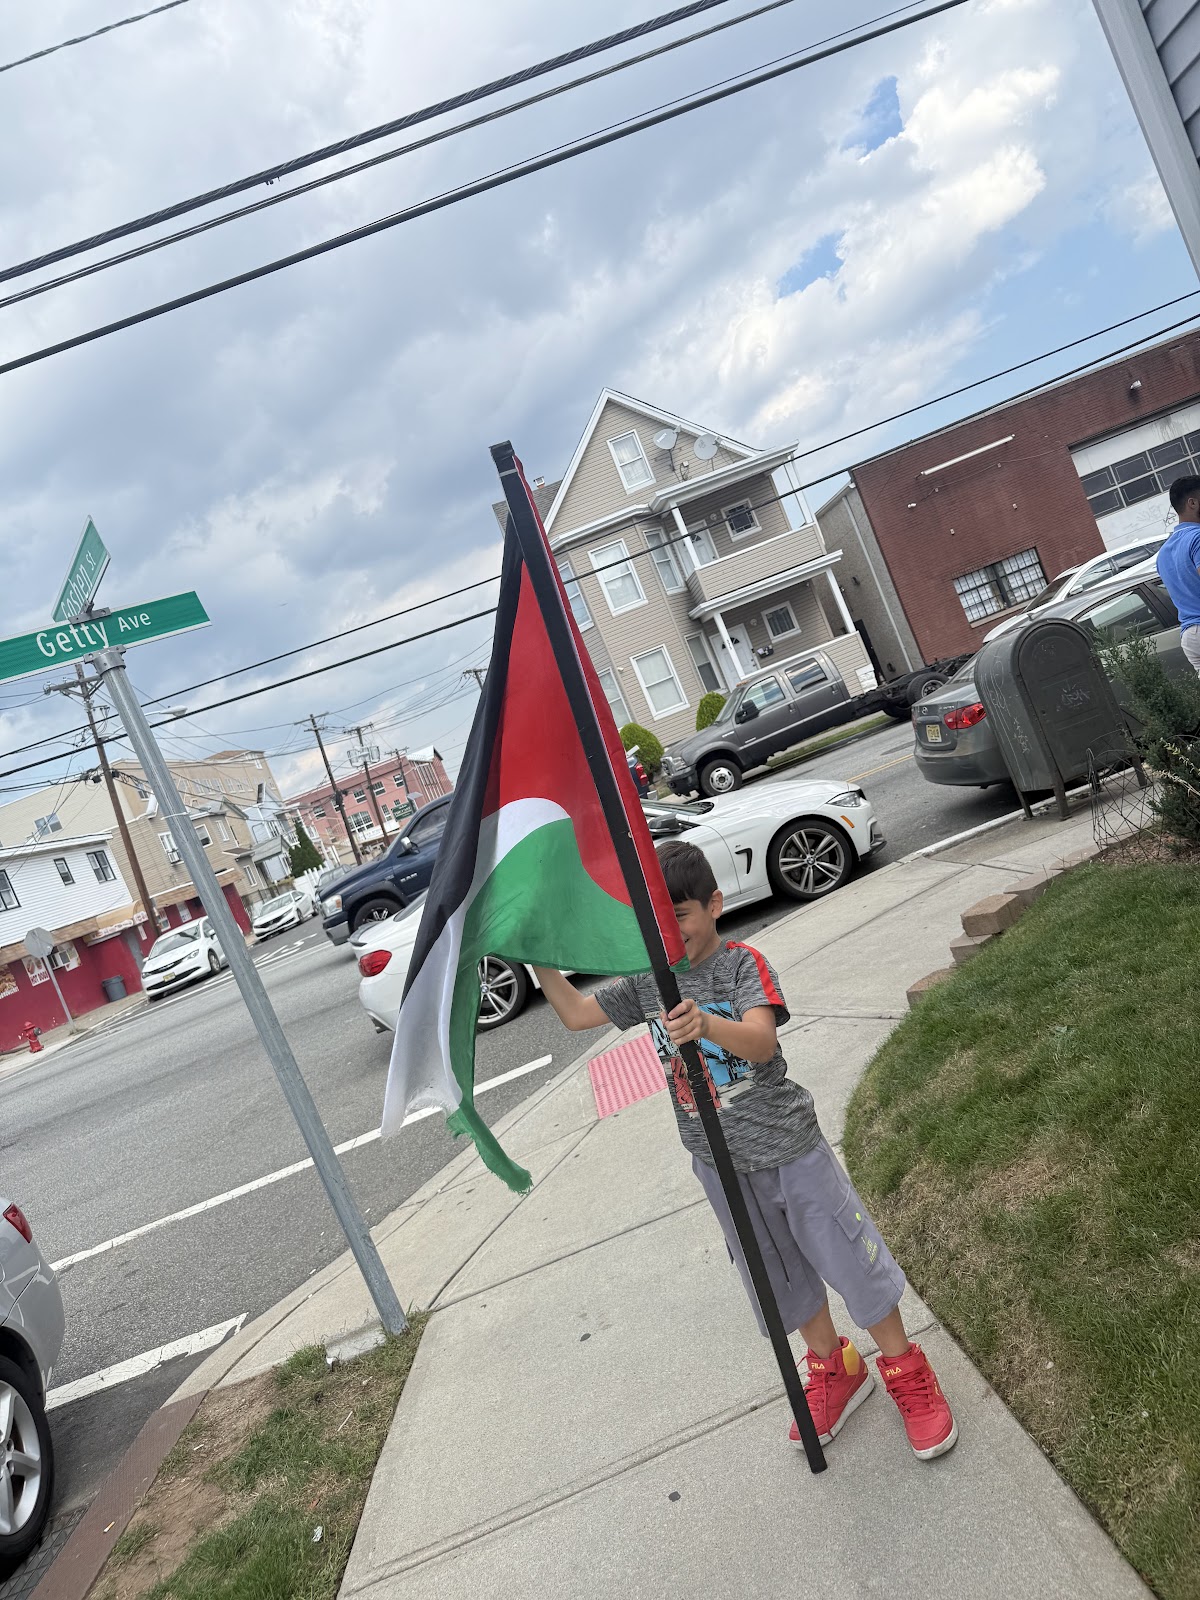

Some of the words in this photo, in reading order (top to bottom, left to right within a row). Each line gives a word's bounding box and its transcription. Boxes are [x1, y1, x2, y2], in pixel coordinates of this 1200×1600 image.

[61, 564, 93, 619] Goshen
[36, 620, 110, 658] Getty
[118, 612, 152, 632] Ave
[811, 1362, 825, 1370] FILA
[886, 1366, 902, 1377] FILA
